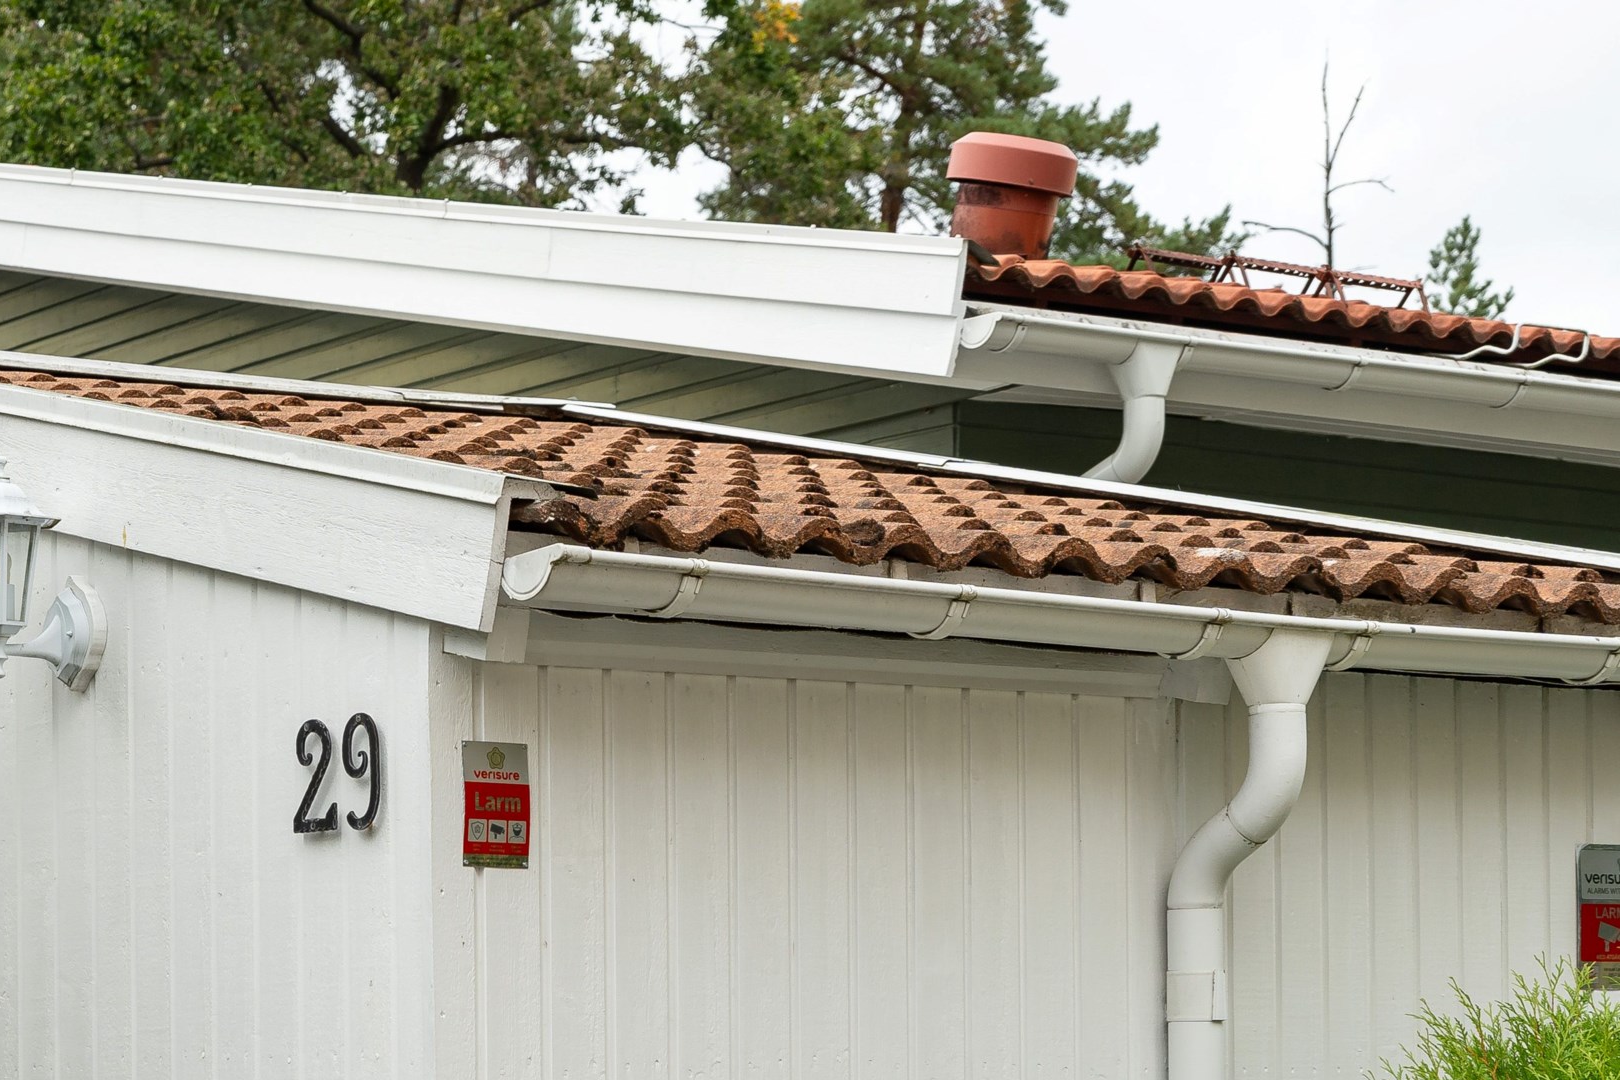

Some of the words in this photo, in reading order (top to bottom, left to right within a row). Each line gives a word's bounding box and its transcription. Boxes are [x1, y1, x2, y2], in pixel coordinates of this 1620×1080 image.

[293, 712, 381, 833] 29
[473, 770, 520, 780] verisure
[474, 791, 521, 812] Larm
[1587, 887, 1609, 895] ALARMS
